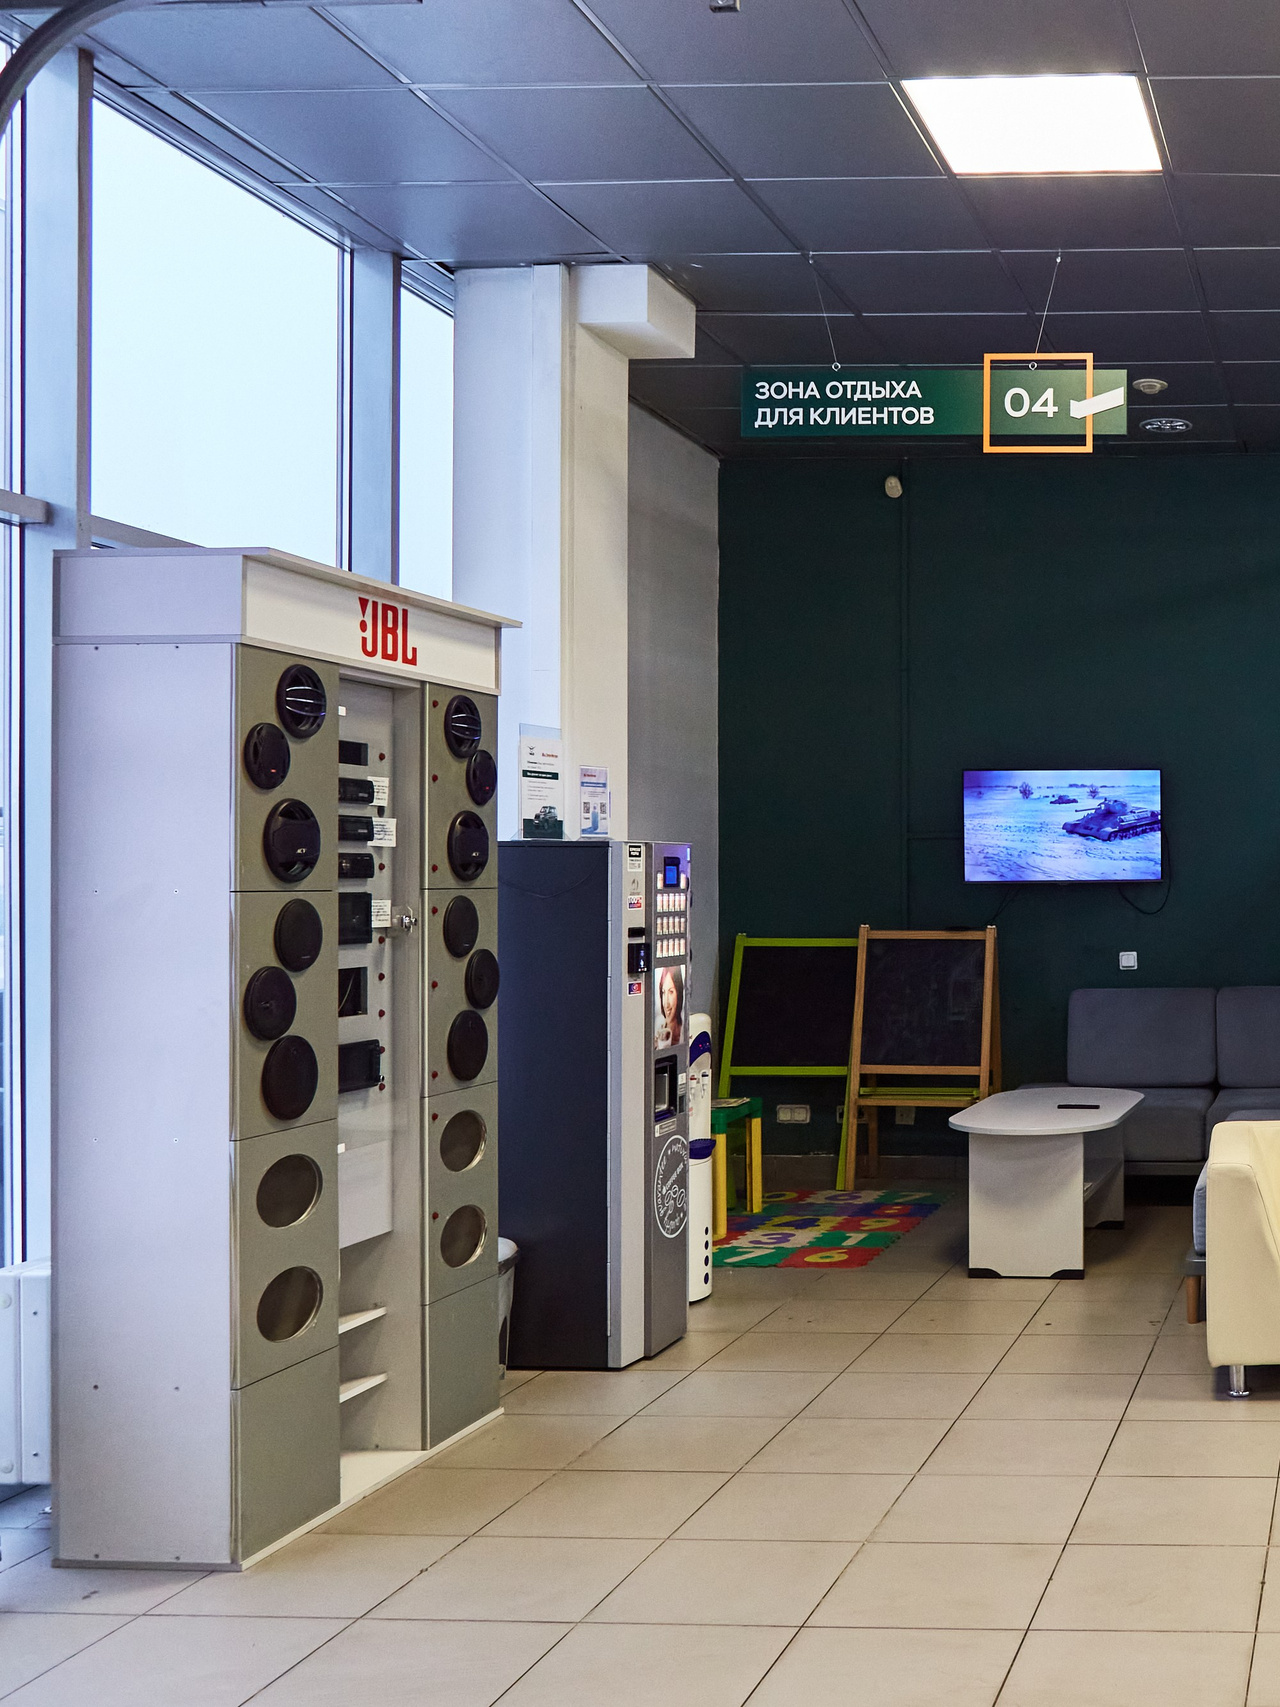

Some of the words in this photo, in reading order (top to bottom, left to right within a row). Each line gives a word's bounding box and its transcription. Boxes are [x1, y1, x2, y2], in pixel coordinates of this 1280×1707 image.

[754, 381, 821, 400] ЗОНА
[824, 380, 922, 401] ОТДЫХА
[1003, 387, 1059, 418] 04
[754, 407, 804, 428] ДЛЯ
[809, 406, 935, 426] КЛИЕНТОВ
[358, 596, 418, 667] JBL
[748, 1232, 797, 1245] 3
